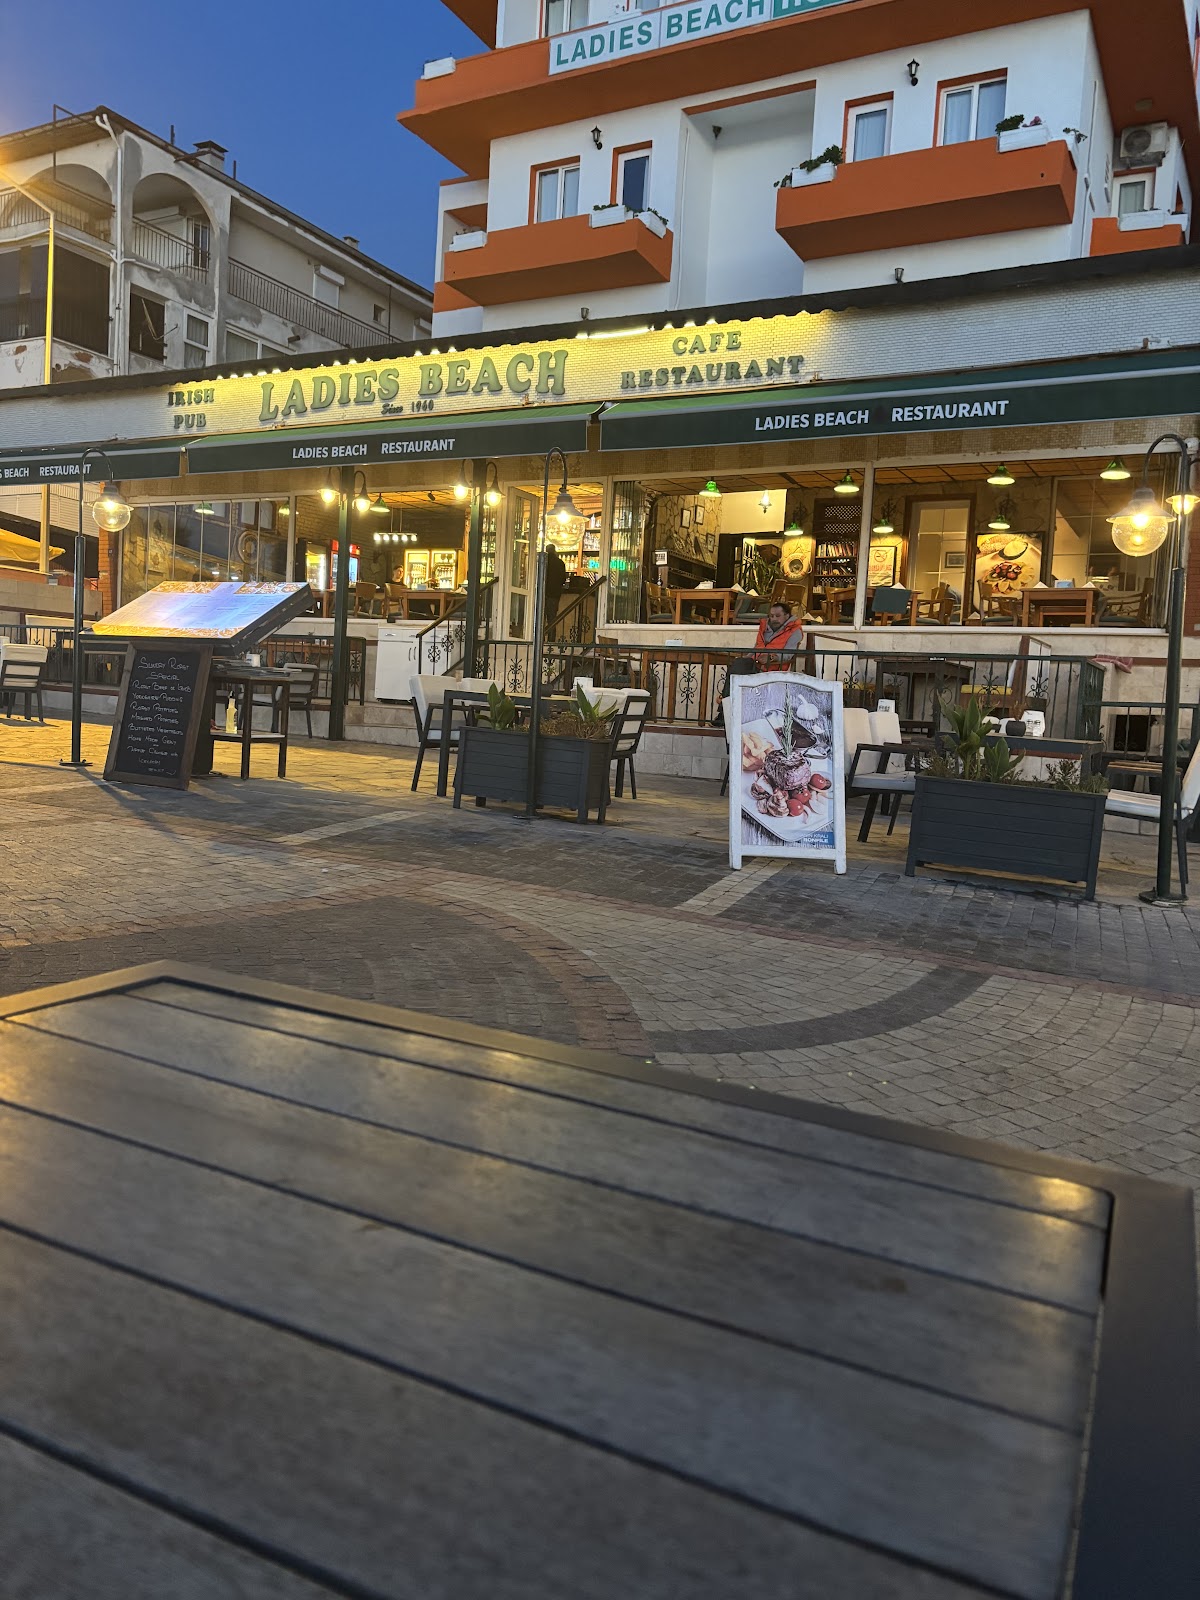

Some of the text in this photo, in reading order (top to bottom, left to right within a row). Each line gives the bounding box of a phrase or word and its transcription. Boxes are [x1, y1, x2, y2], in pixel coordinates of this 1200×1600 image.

[556, 0, 766, 66] LADIES BEACH
[672, 331, 742, 355] CAFE
[620, 355, 804, 389] RESTAURANT
[168, 388, 215, 406] IRISH
[259, 350, 568, 422] LADIES BEACH
[411, 399, 434, 413] 1960
[755, 400, 1010, 431] LADIES BEACH RESTAURANT
[173, 413, 207, 429] PUB
[292, 439, 456, 459] LADIES BEACH RESTAURANT
[4, 467, 30, 479] BEACH
